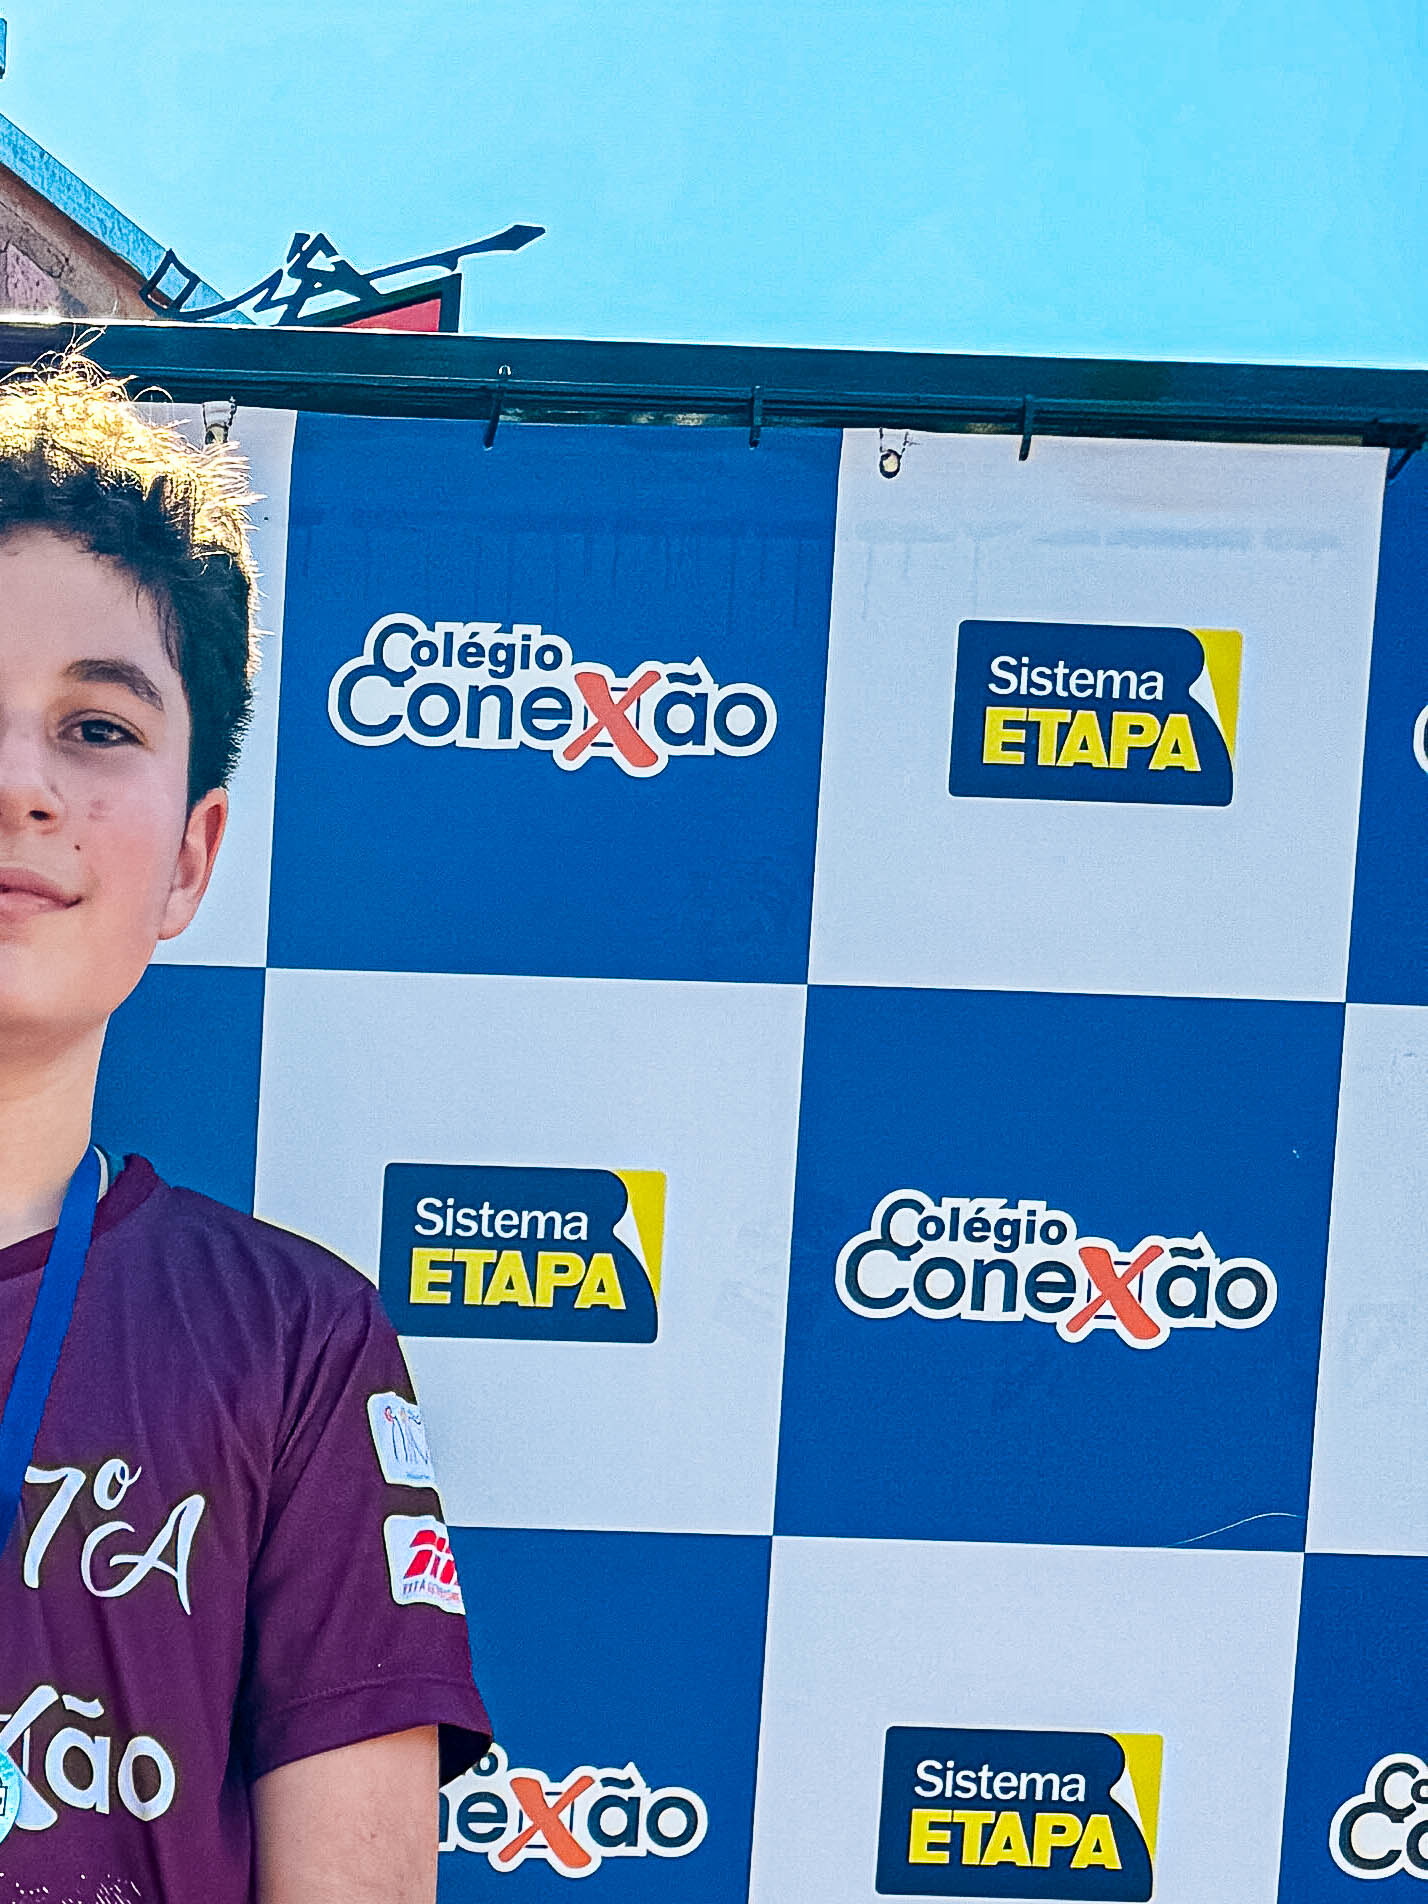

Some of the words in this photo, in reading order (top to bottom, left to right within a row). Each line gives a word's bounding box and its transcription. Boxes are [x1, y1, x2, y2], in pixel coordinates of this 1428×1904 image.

[373, 622, 564, 679] Colégio
[987, 655, 1165, 700] Sistema
[982, 706, 1201, 772] ETAPA
[413, 1197, 589, 1240] Sistema
[881, 1198, 1068, 1253] Colégio
[409, 1247, 626, 1310] ETAPA
[913, 1759, 1087, 1802] Sistema
[908, 1808, 1122, 1870] ETAPA
